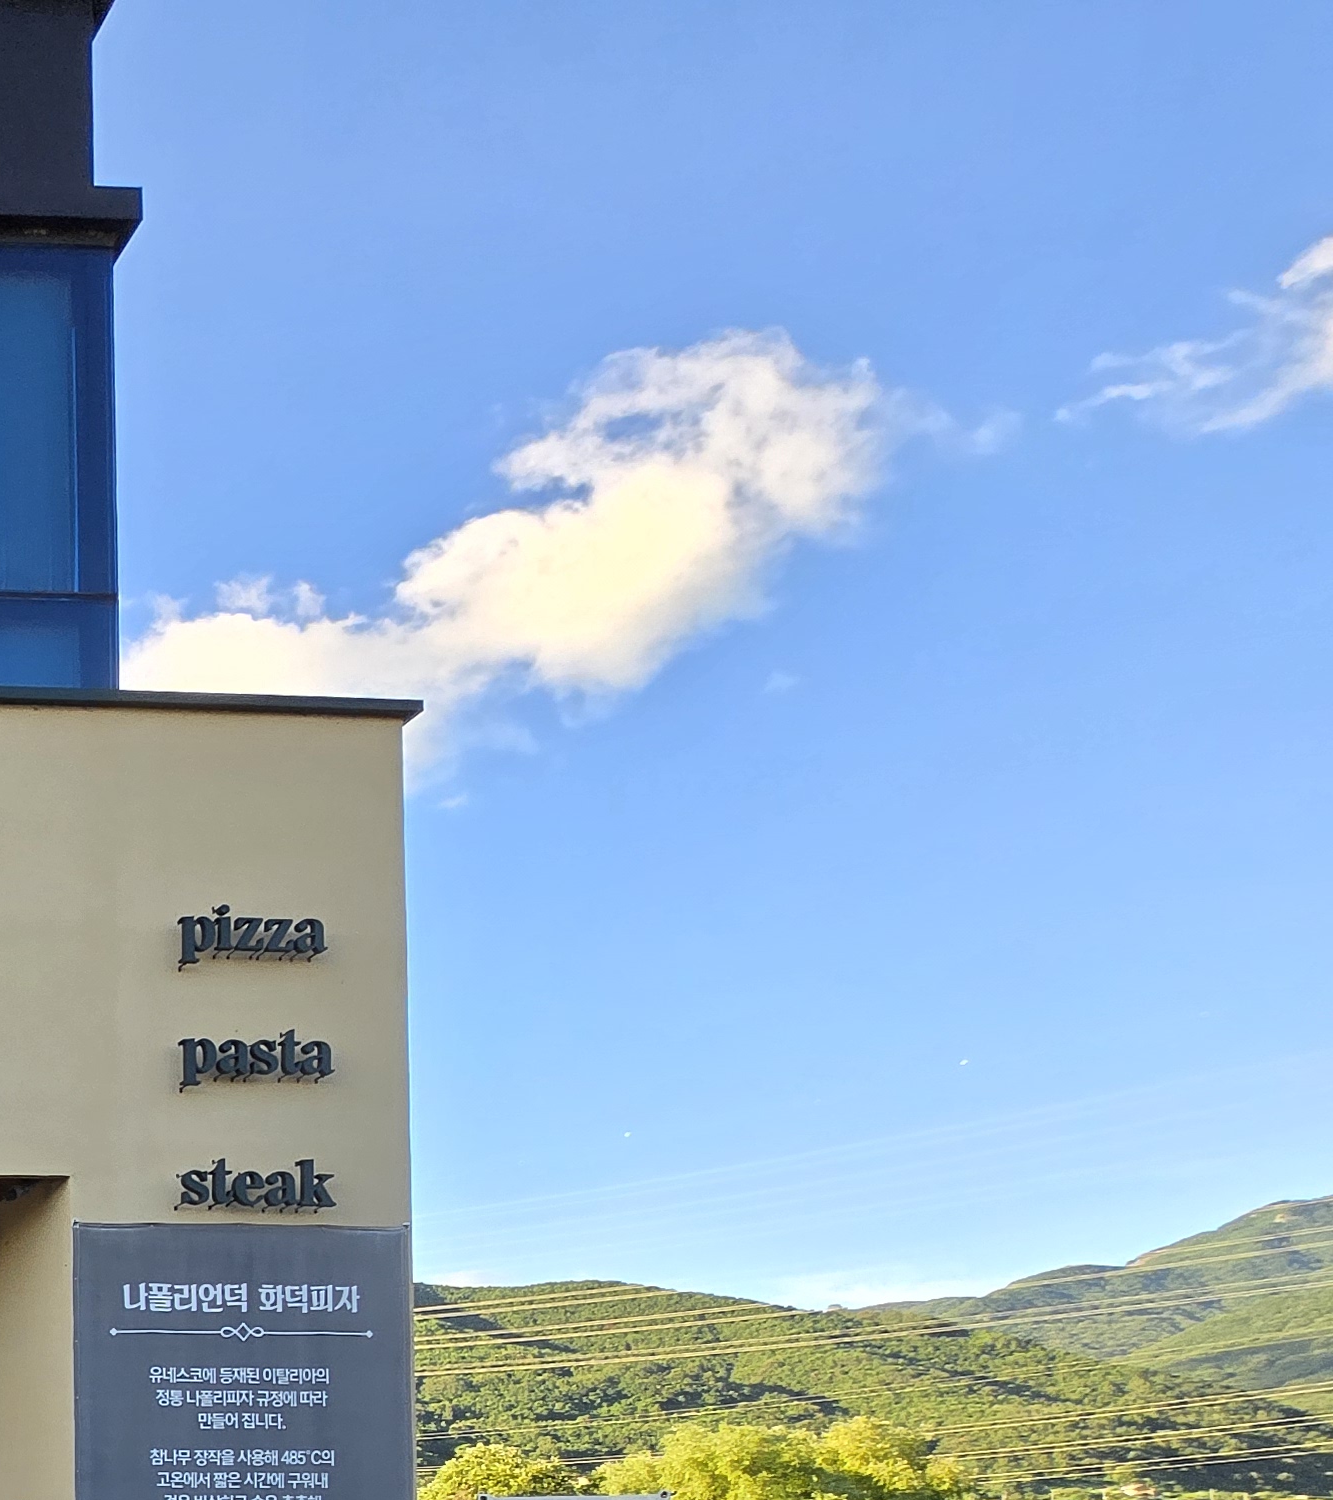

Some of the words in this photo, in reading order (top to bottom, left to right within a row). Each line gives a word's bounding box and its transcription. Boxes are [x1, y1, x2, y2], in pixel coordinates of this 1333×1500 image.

[177, 904, 328, 964] pizza
[177, 1029, 335, 1087] pasta
[176, 1158, 337, 1211] steak
[123, 1282, 248, 1313] 나폴리언덕
[258, 1284, 360, 1313] 화덕피자
[149, 1366, 216, 1384] 유네스코에
[219, 1367, 260, 1384] 등재된
[263, 1367, 330, 1384] 이탈리아의
[156, 1389, 183, 1406] 정통
[187, 1390, 254, 1407] 나폴리피자
[256, 1390, 297, 1406] 규정에
[300, 1390, 328, 1407] 따라
[198, 1413, 238, 1430] 만들어
[242, 1413, 287, 1430] 집니다.
[150, 1448, 191, 1466] 참나무
[194, 1449, 235, 1466] 장작을
[237, 1449, 278, 1466] 사용해
[156, 1472, 210, 1489] 고온에서
[213, 1472, 242, 1488] 짧은
[244, 1472, 284, 1489] 시간에
[288, 1472, 329, 1489] 구워내
